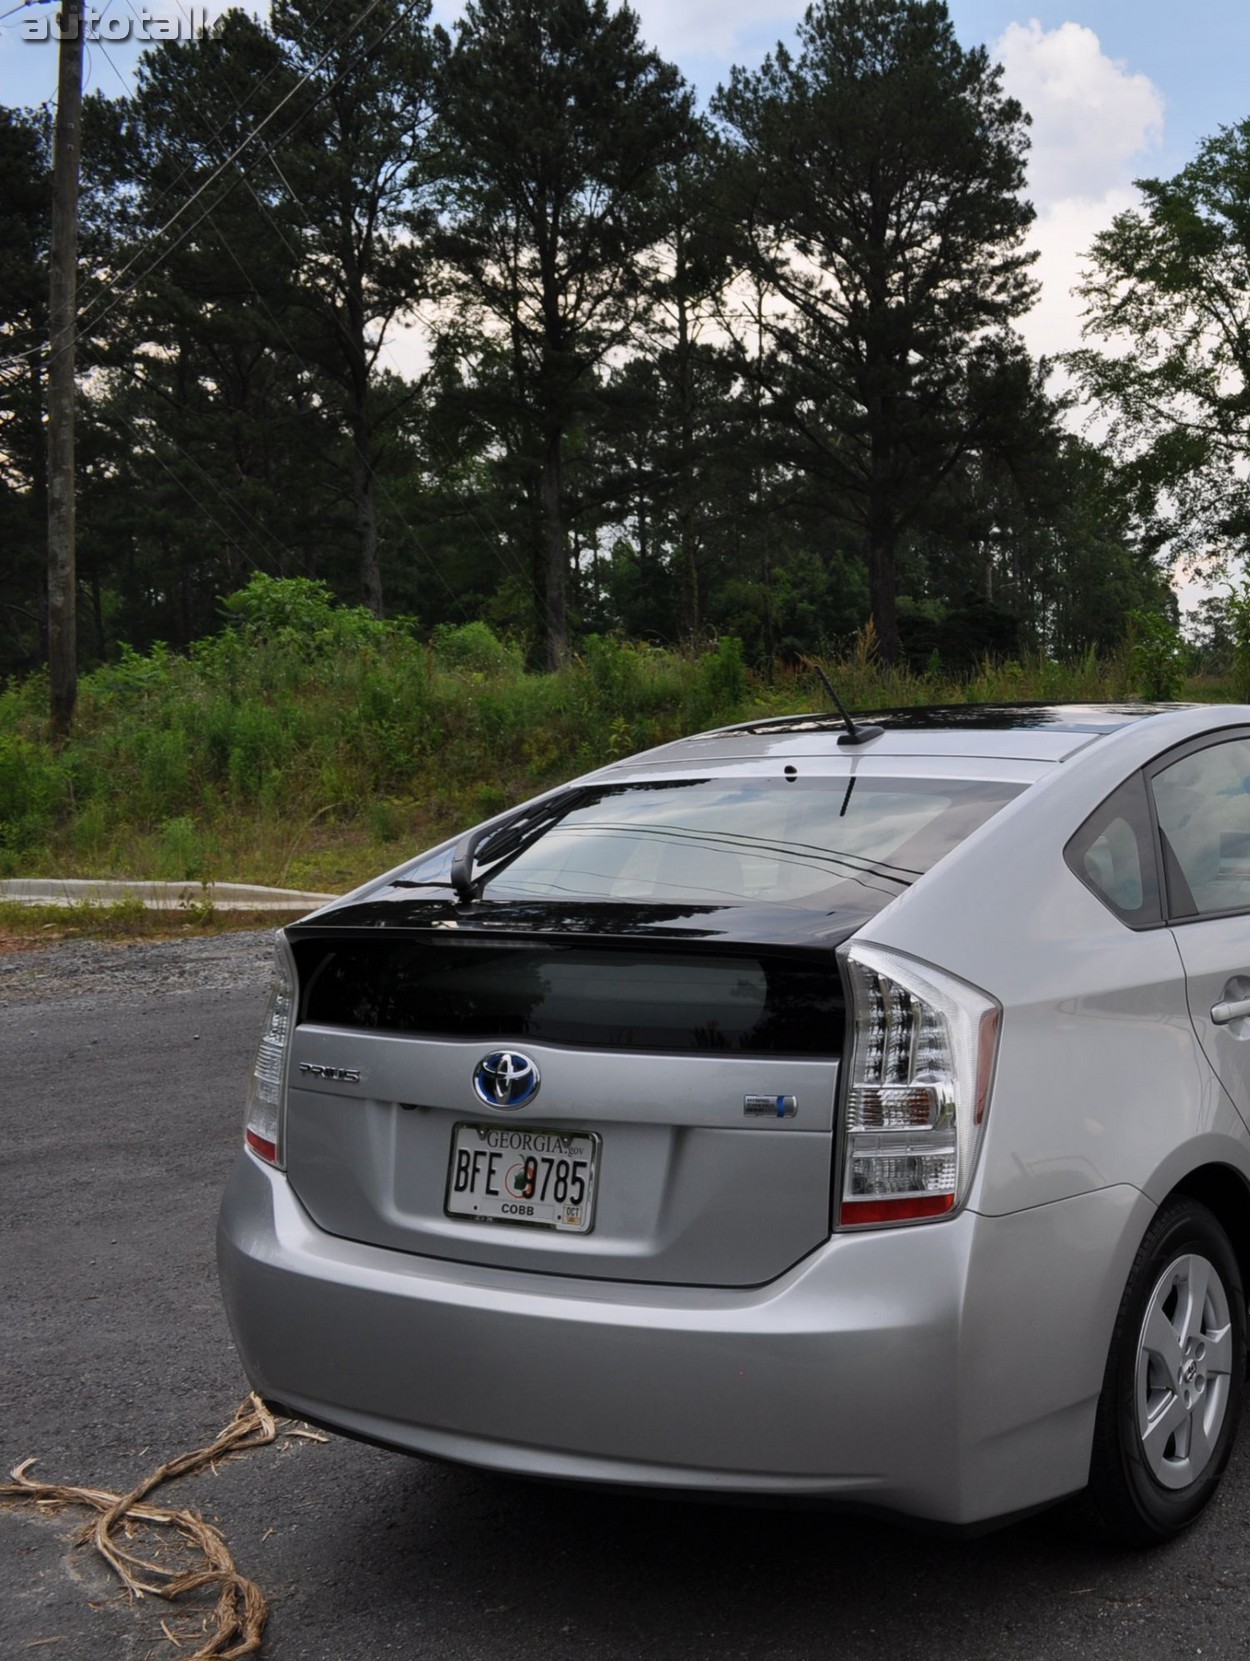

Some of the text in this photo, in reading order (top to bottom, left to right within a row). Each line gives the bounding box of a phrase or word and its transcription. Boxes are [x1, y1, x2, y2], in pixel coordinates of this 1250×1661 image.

[454, 1149, 587, 1205] BFE 9785
[501, 1203, 534, 1216] COBB
